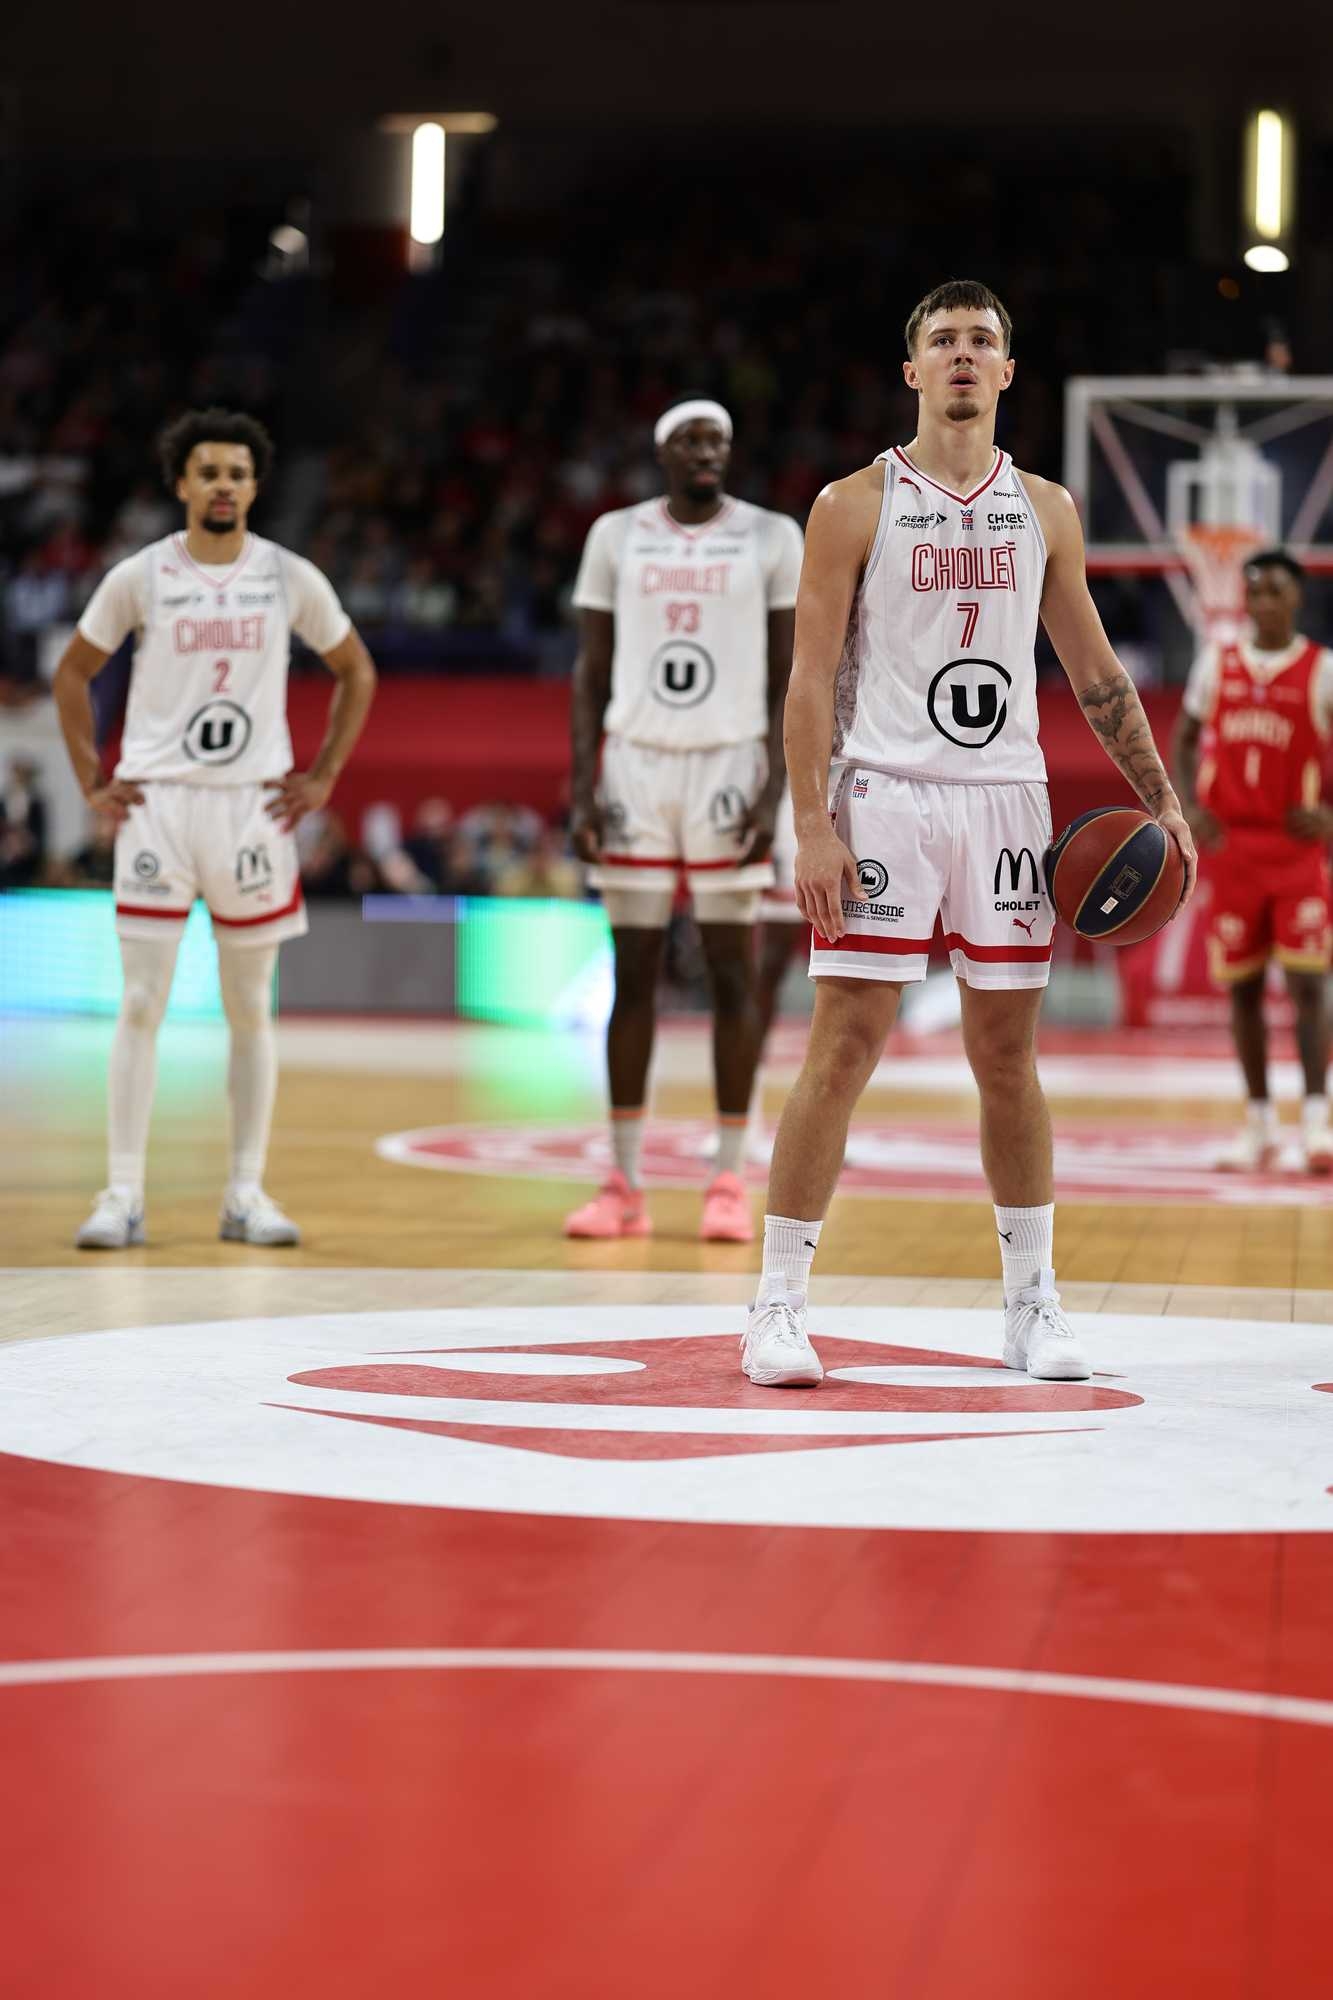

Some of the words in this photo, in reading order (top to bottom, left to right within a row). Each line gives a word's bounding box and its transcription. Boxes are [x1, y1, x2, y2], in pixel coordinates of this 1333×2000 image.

[643, 564, 730, 594] CHOLET
[912, 541, 1016, 593] CHOLET
[664, 601, 702, 634] 93
[956, 602, 980, 648] 7
[176, 616, 265, 654] CHOLET
[212, 659, 229, 692] 2
[664, 661, 696, 693] U
[950, 684, 997, 728] U
[201, 720, 233, 750] U
[994, 900, 1041, 911] CHOLET
